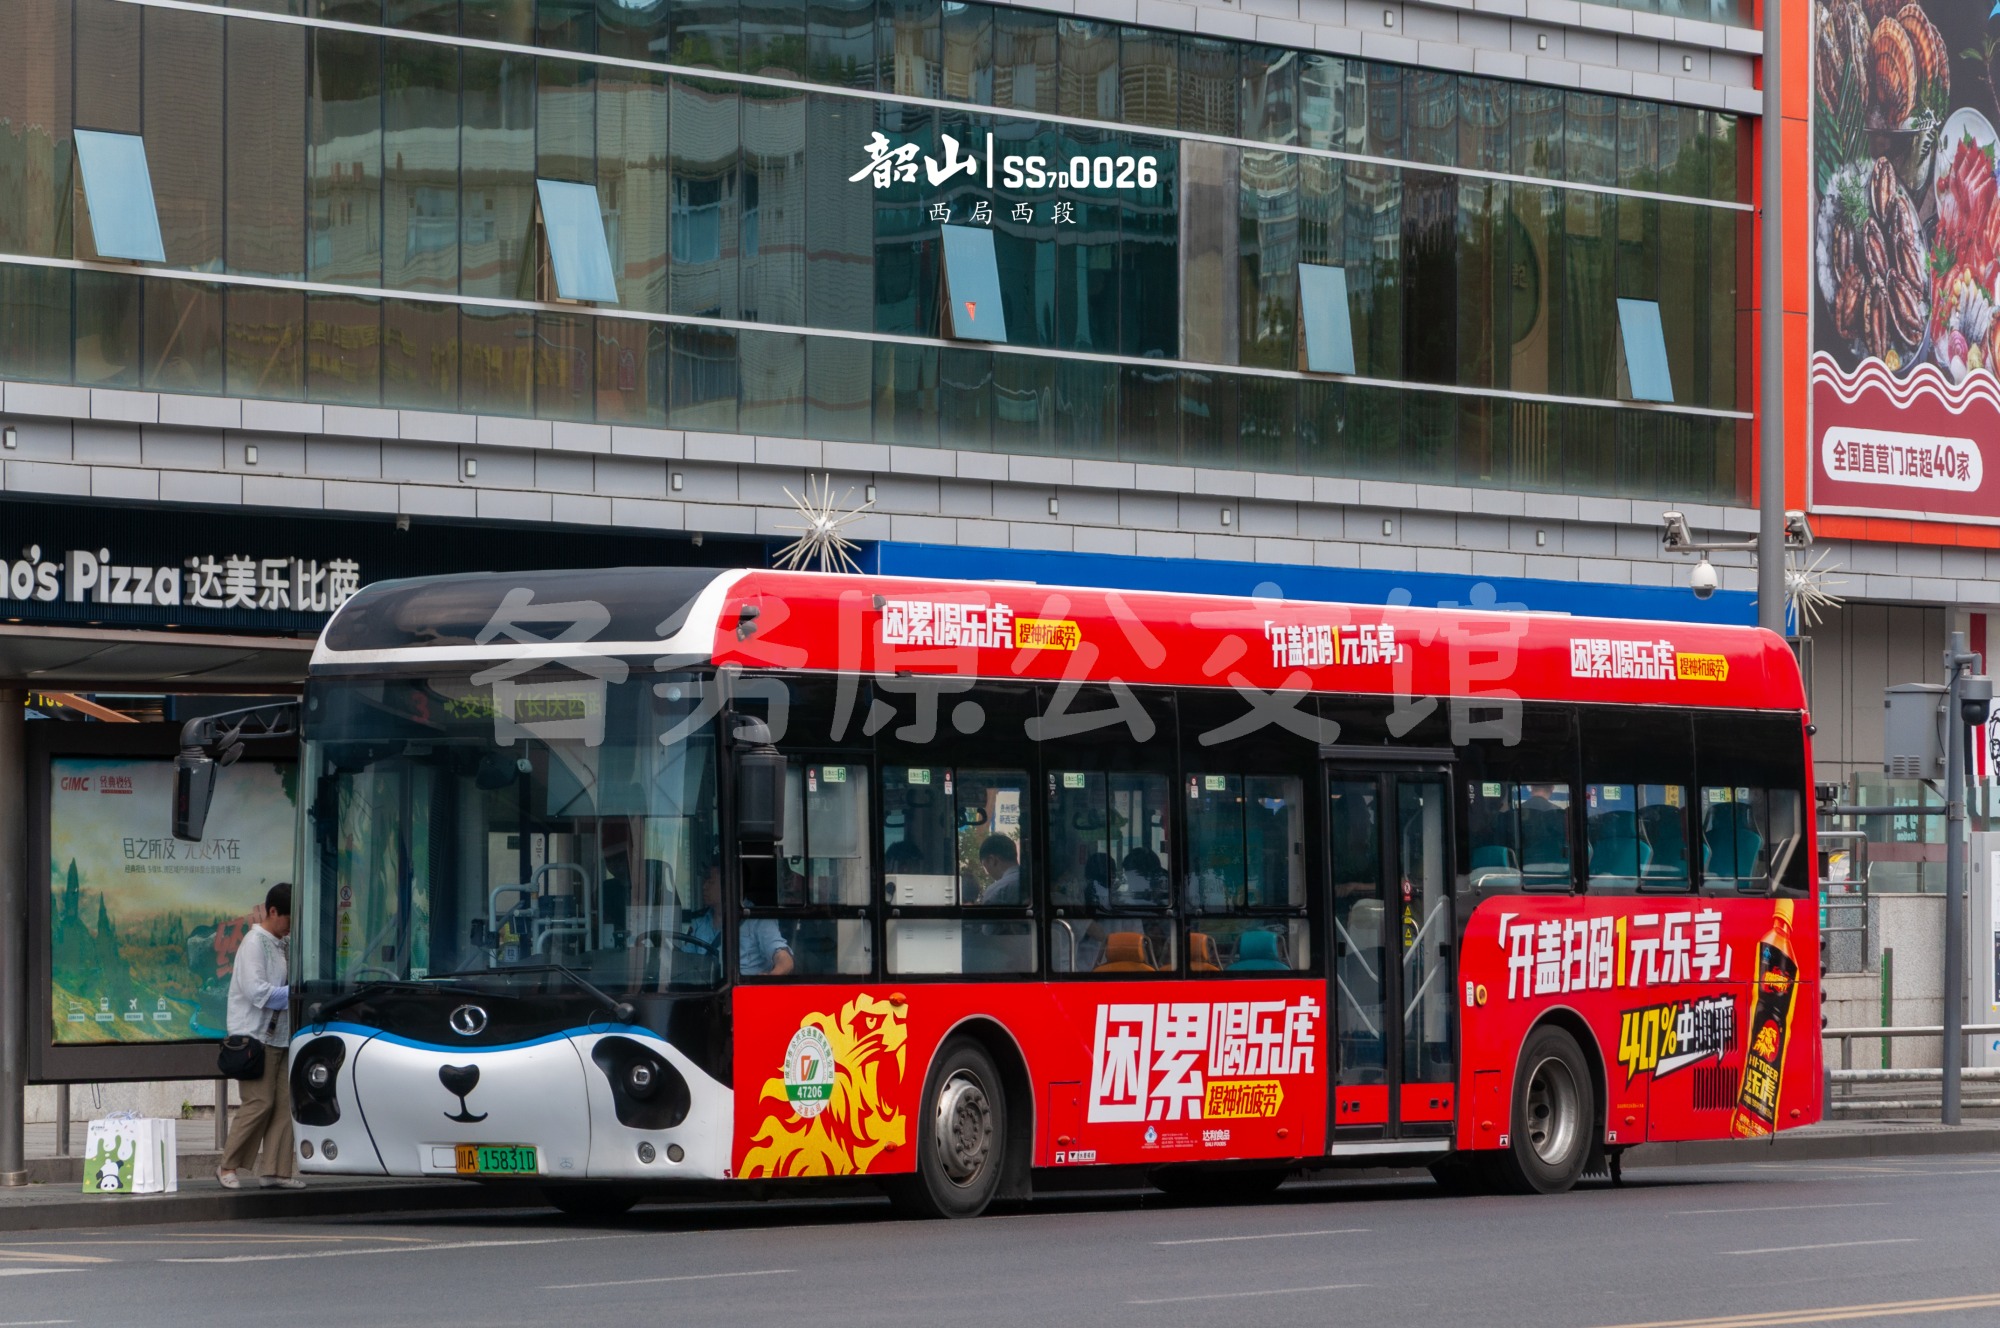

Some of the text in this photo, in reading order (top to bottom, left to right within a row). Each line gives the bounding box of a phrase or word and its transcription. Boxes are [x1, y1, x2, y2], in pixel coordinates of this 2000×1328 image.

[1832, 439, 1971, 483] 全国直营门店超40家
[72, 547, 181, 606] Pizza
[189, 553, 360, 613] 达美乐比萨
[881, 600, 1077, 650] 困累喝乐虎 提神抗疲劳
[1570, 638, 1726, 682] 困累喝乐虎 提神抗疲劳
[61, 776, 90, 792] GIMC
[123, 837, 176, 860] 目之所及
[1087, 995, 1321, 1124] 困累喝乐虎
[797, 1085, 823, 1098] 47206
[1207, 1083, 1278, 1118] 提神抗疲劳
[1202, 1129, 1231, 1142] 达利食品
